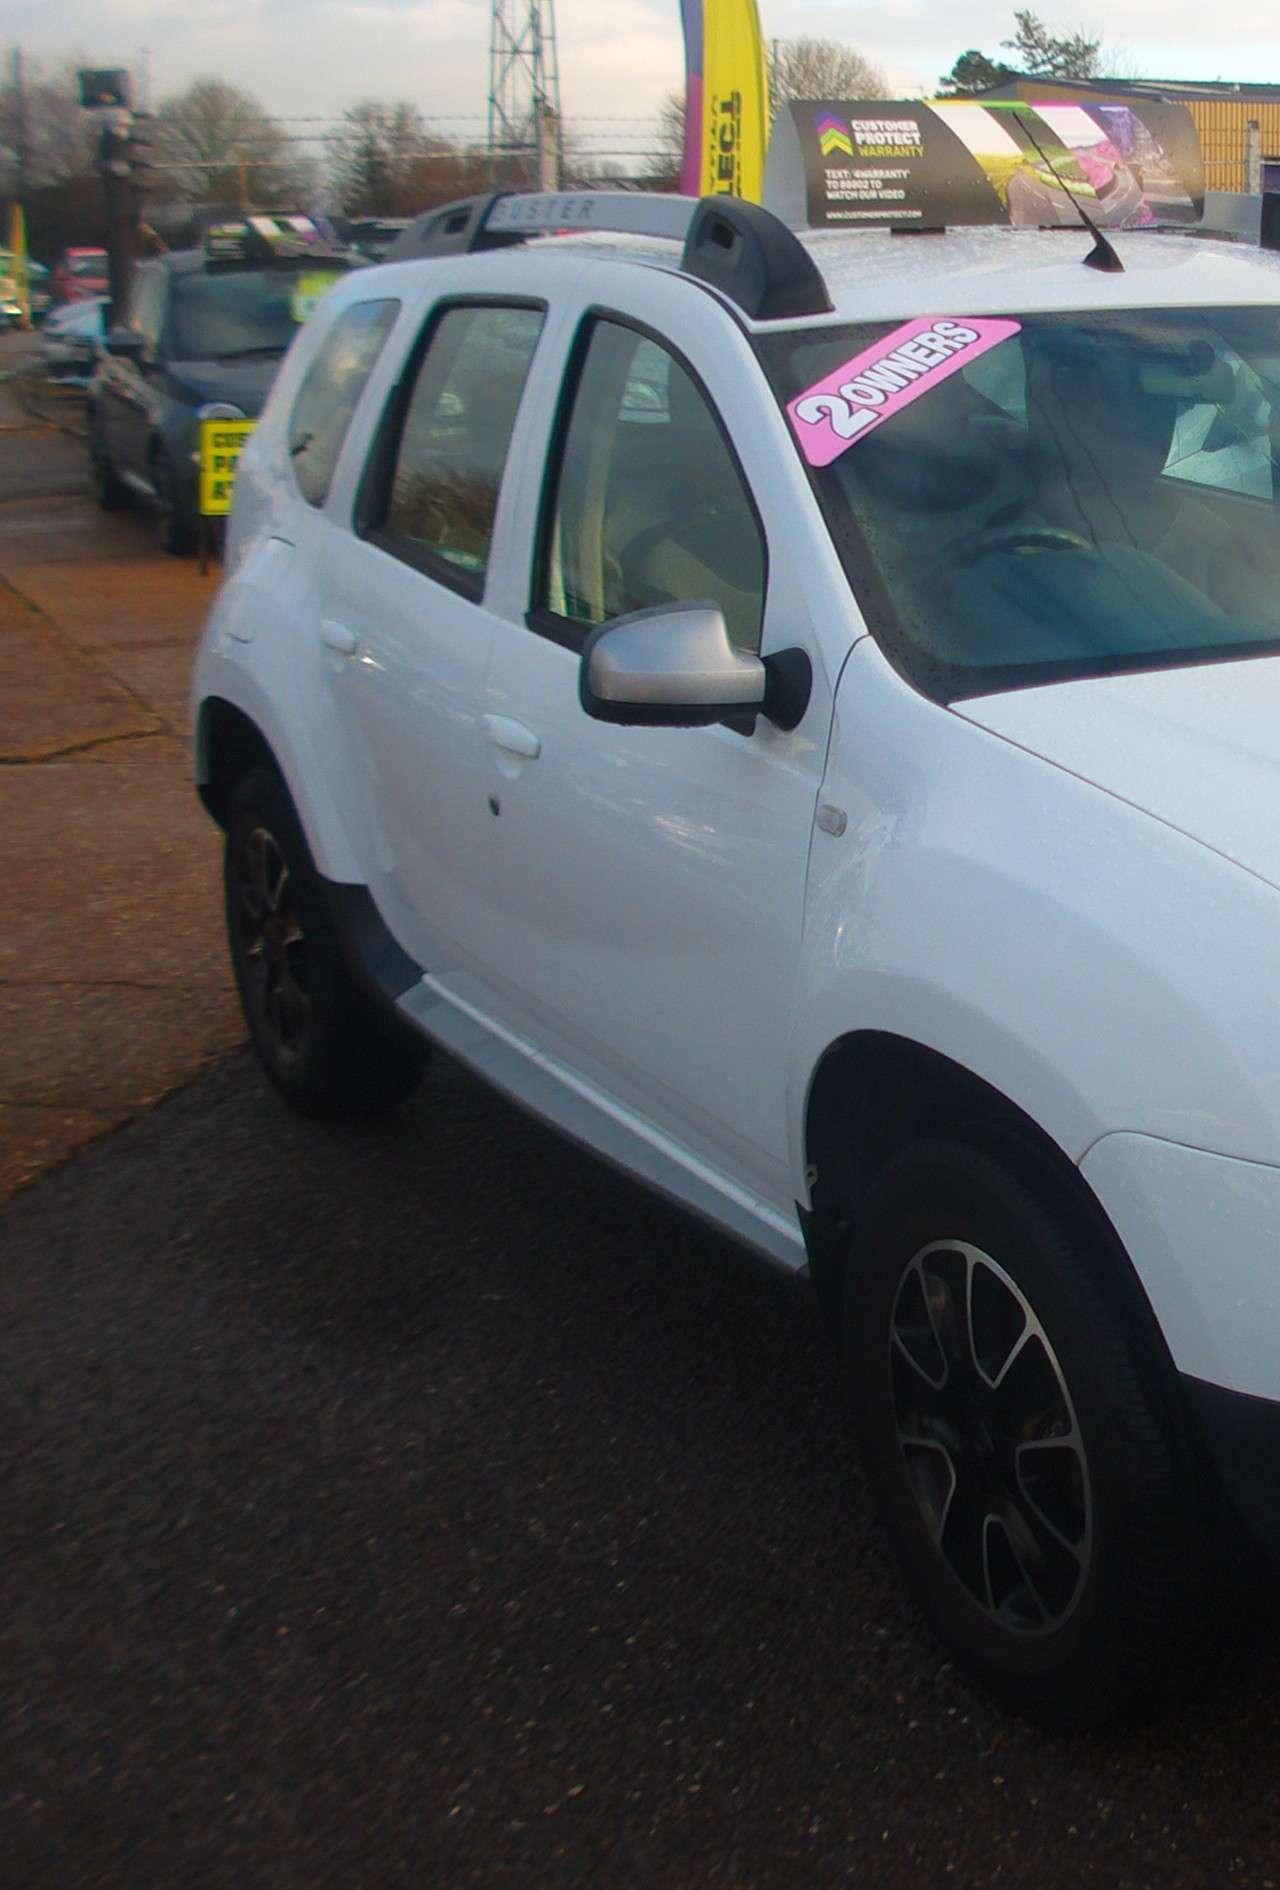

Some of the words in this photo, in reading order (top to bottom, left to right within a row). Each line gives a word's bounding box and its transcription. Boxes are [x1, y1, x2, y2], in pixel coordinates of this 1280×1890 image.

[851, 119, 919, 132] CUSTOMER
[855, 131, 921, 146] PROTECT
[859, 145, 925, 158] WARRANTY
